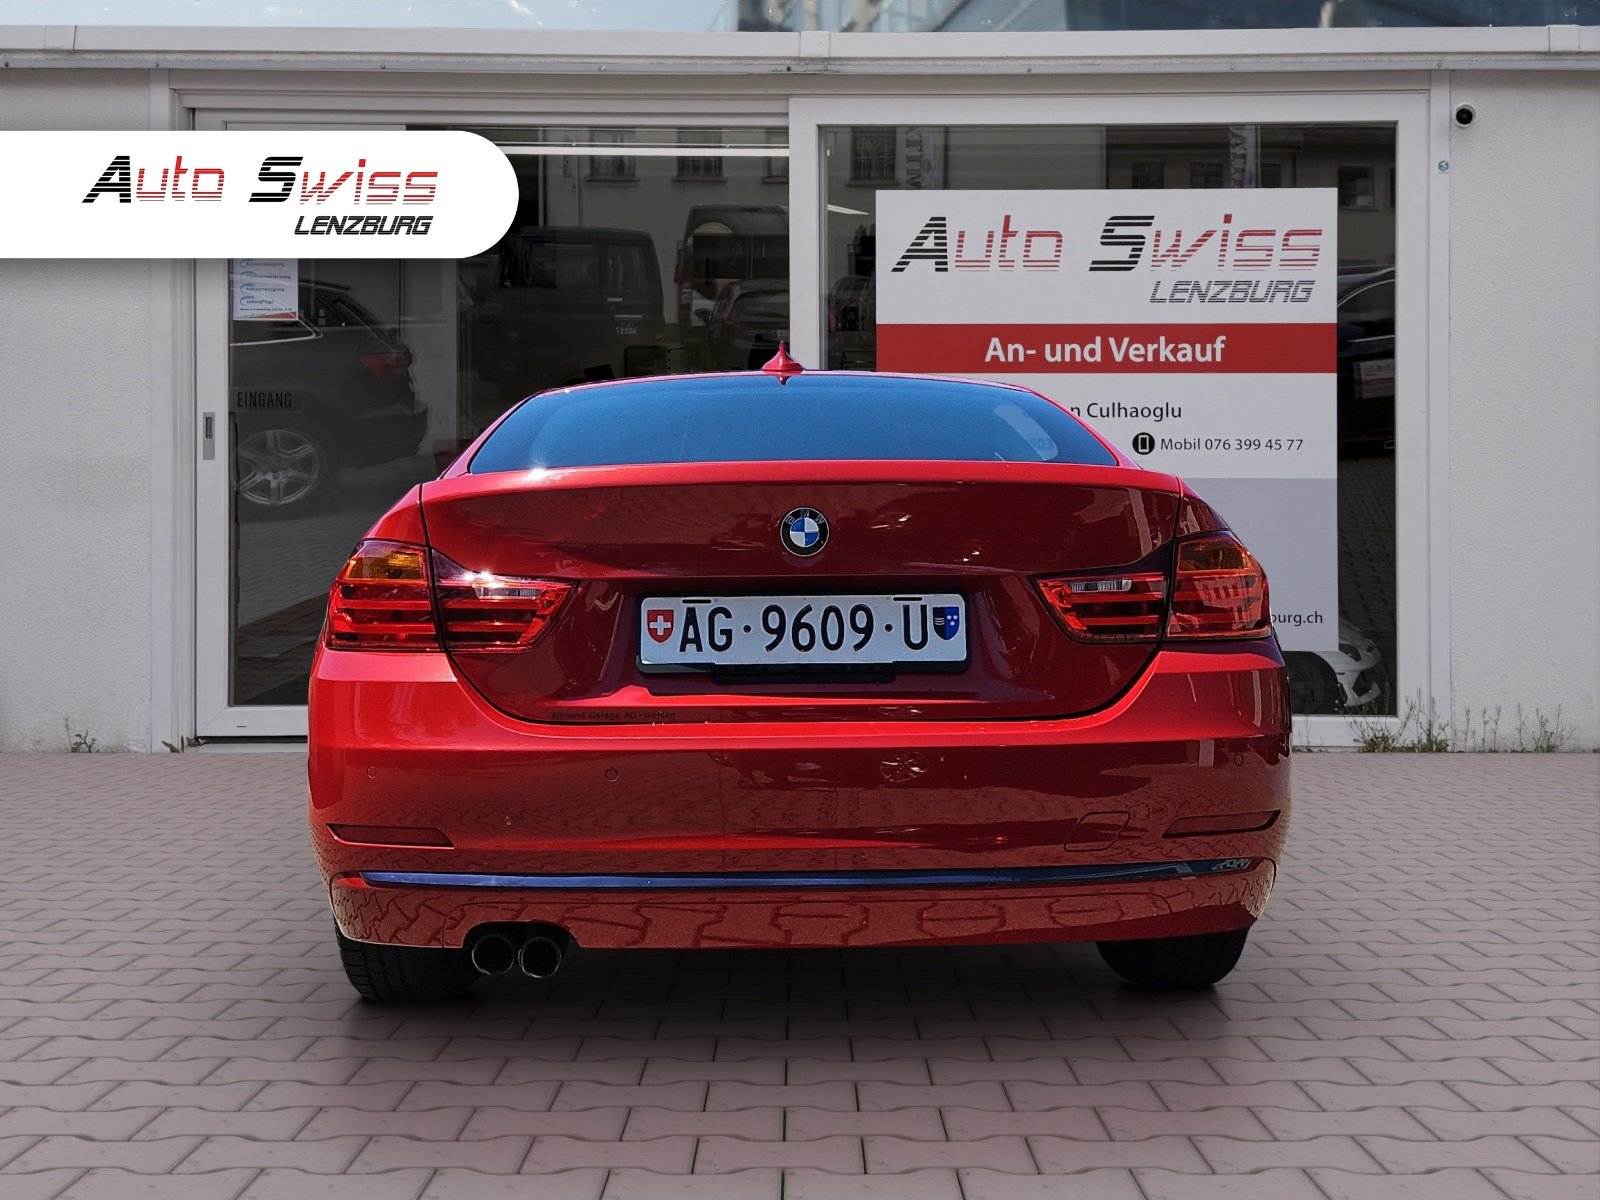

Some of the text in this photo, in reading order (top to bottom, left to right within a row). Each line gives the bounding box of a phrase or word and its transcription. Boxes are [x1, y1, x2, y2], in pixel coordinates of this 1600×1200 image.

[891, 213, 1322, 272] Auto Swiss
[1150, 280, 1315, 304] LENZBURG
[985, 336, 1226, 362] An- und Verkauf
[236, 391, 293, 409] EINGANG
[1086, 401, 1182, 422] Culhaoglu
[1160, 437, 1304, 451] Mobil 076 399 45 77
[785, 509, 825, 526] BMW
